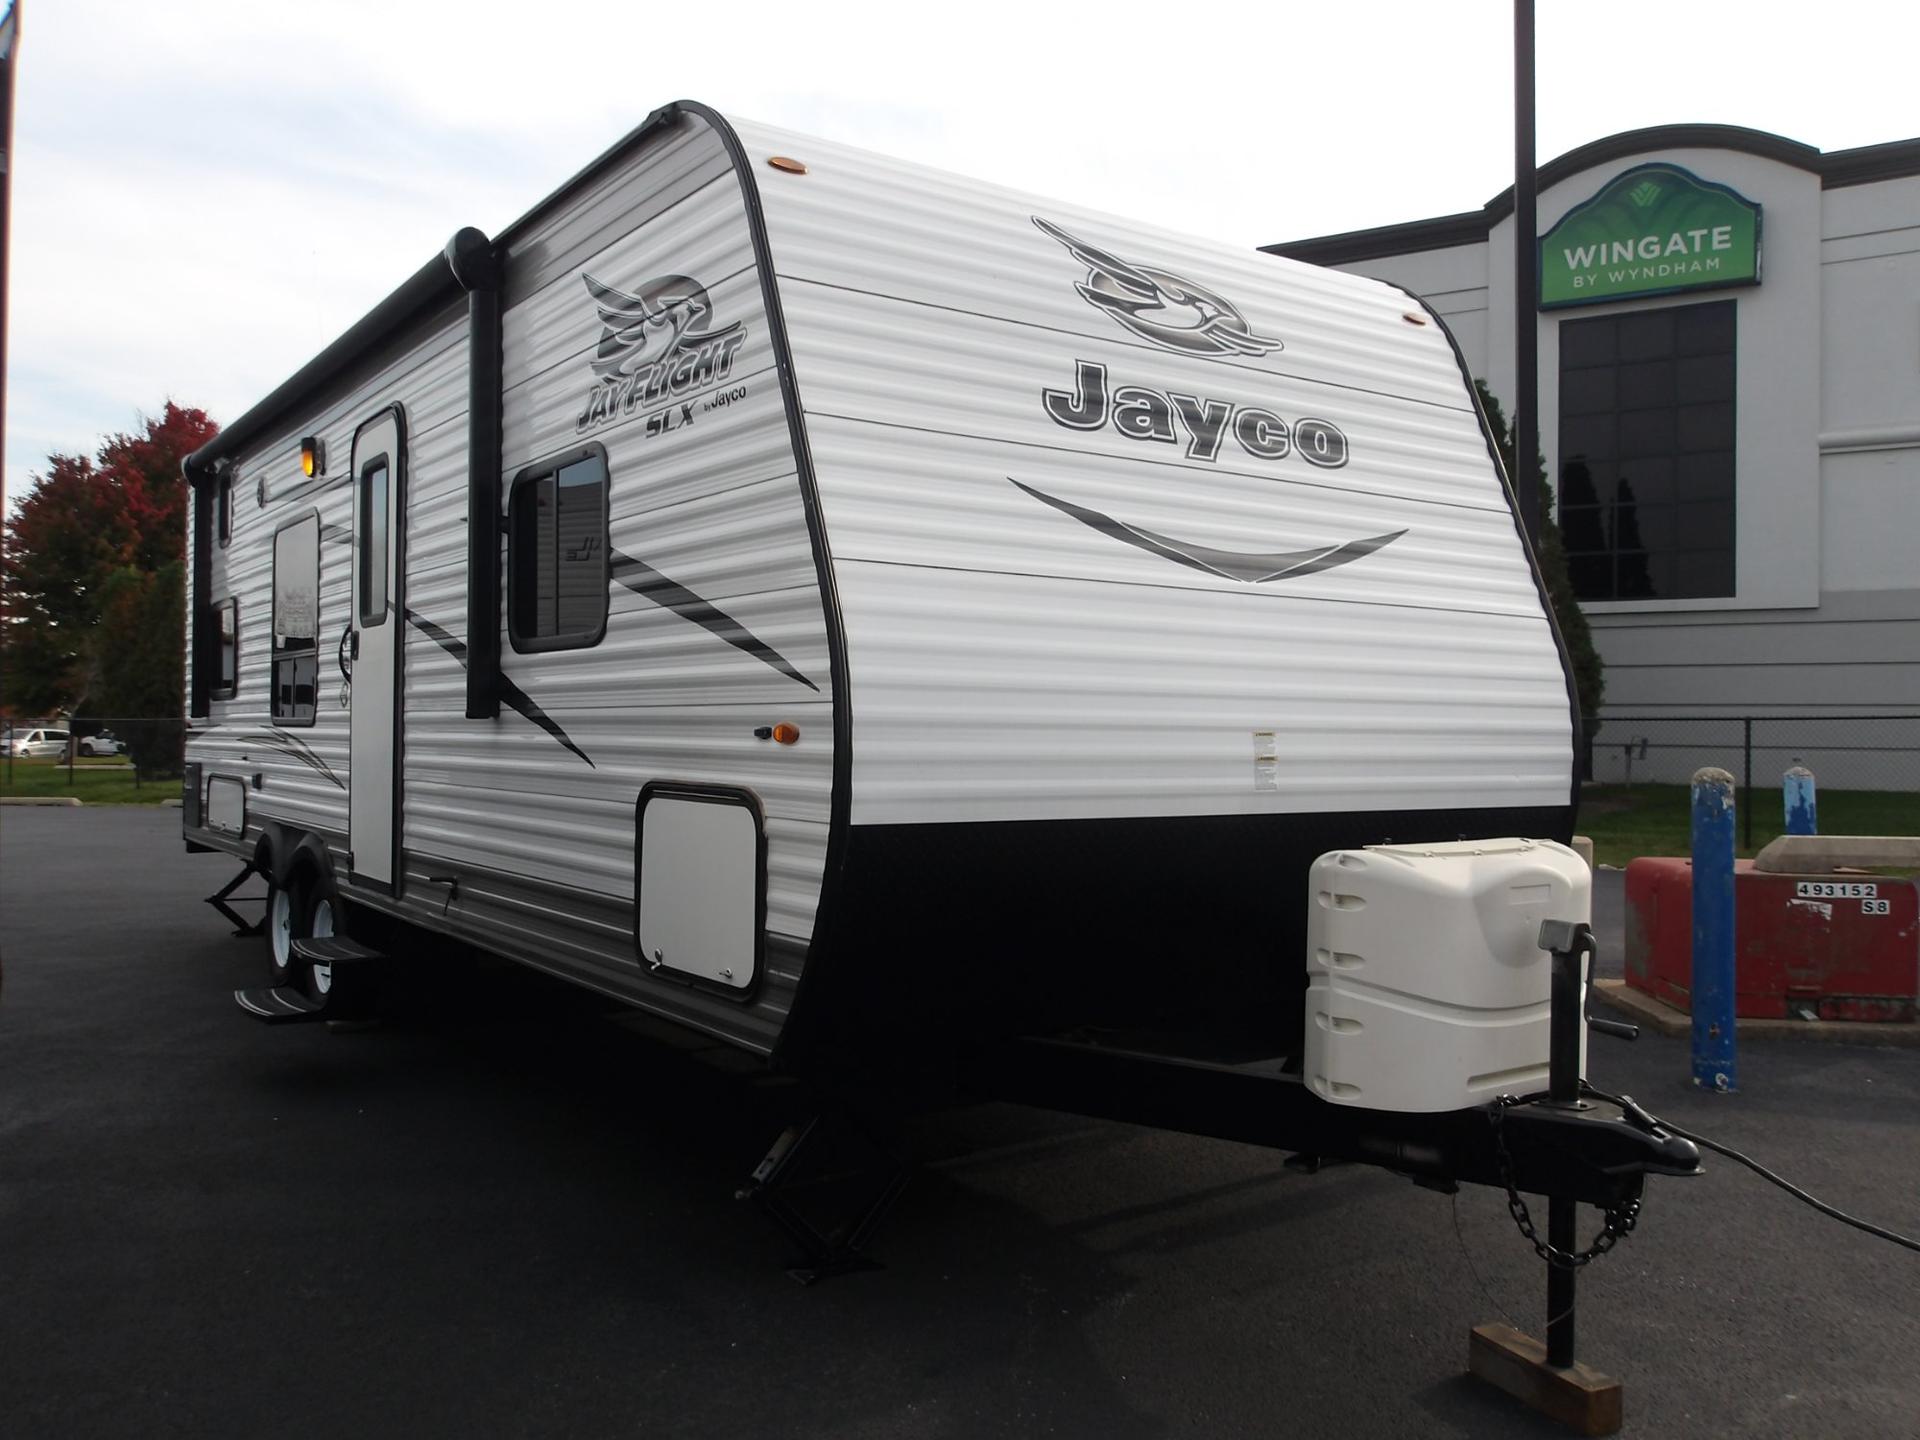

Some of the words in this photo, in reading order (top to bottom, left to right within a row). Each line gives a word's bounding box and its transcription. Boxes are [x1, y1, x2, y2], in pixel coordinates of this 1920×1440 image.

[1563, 225, 1732, 270] WINGATE
[1573, 274, 1598, 288] BY
[1608, 257, 1720, 283] WYNDHAM
[646, 400, 697, 438] SLX
[711, 386, 746, 408] Jayco
[1042, 359, 1348, 468] Jayco
[1799, 884, 1875, 897] 493152
[1863, 901, 1887, 913] S8
